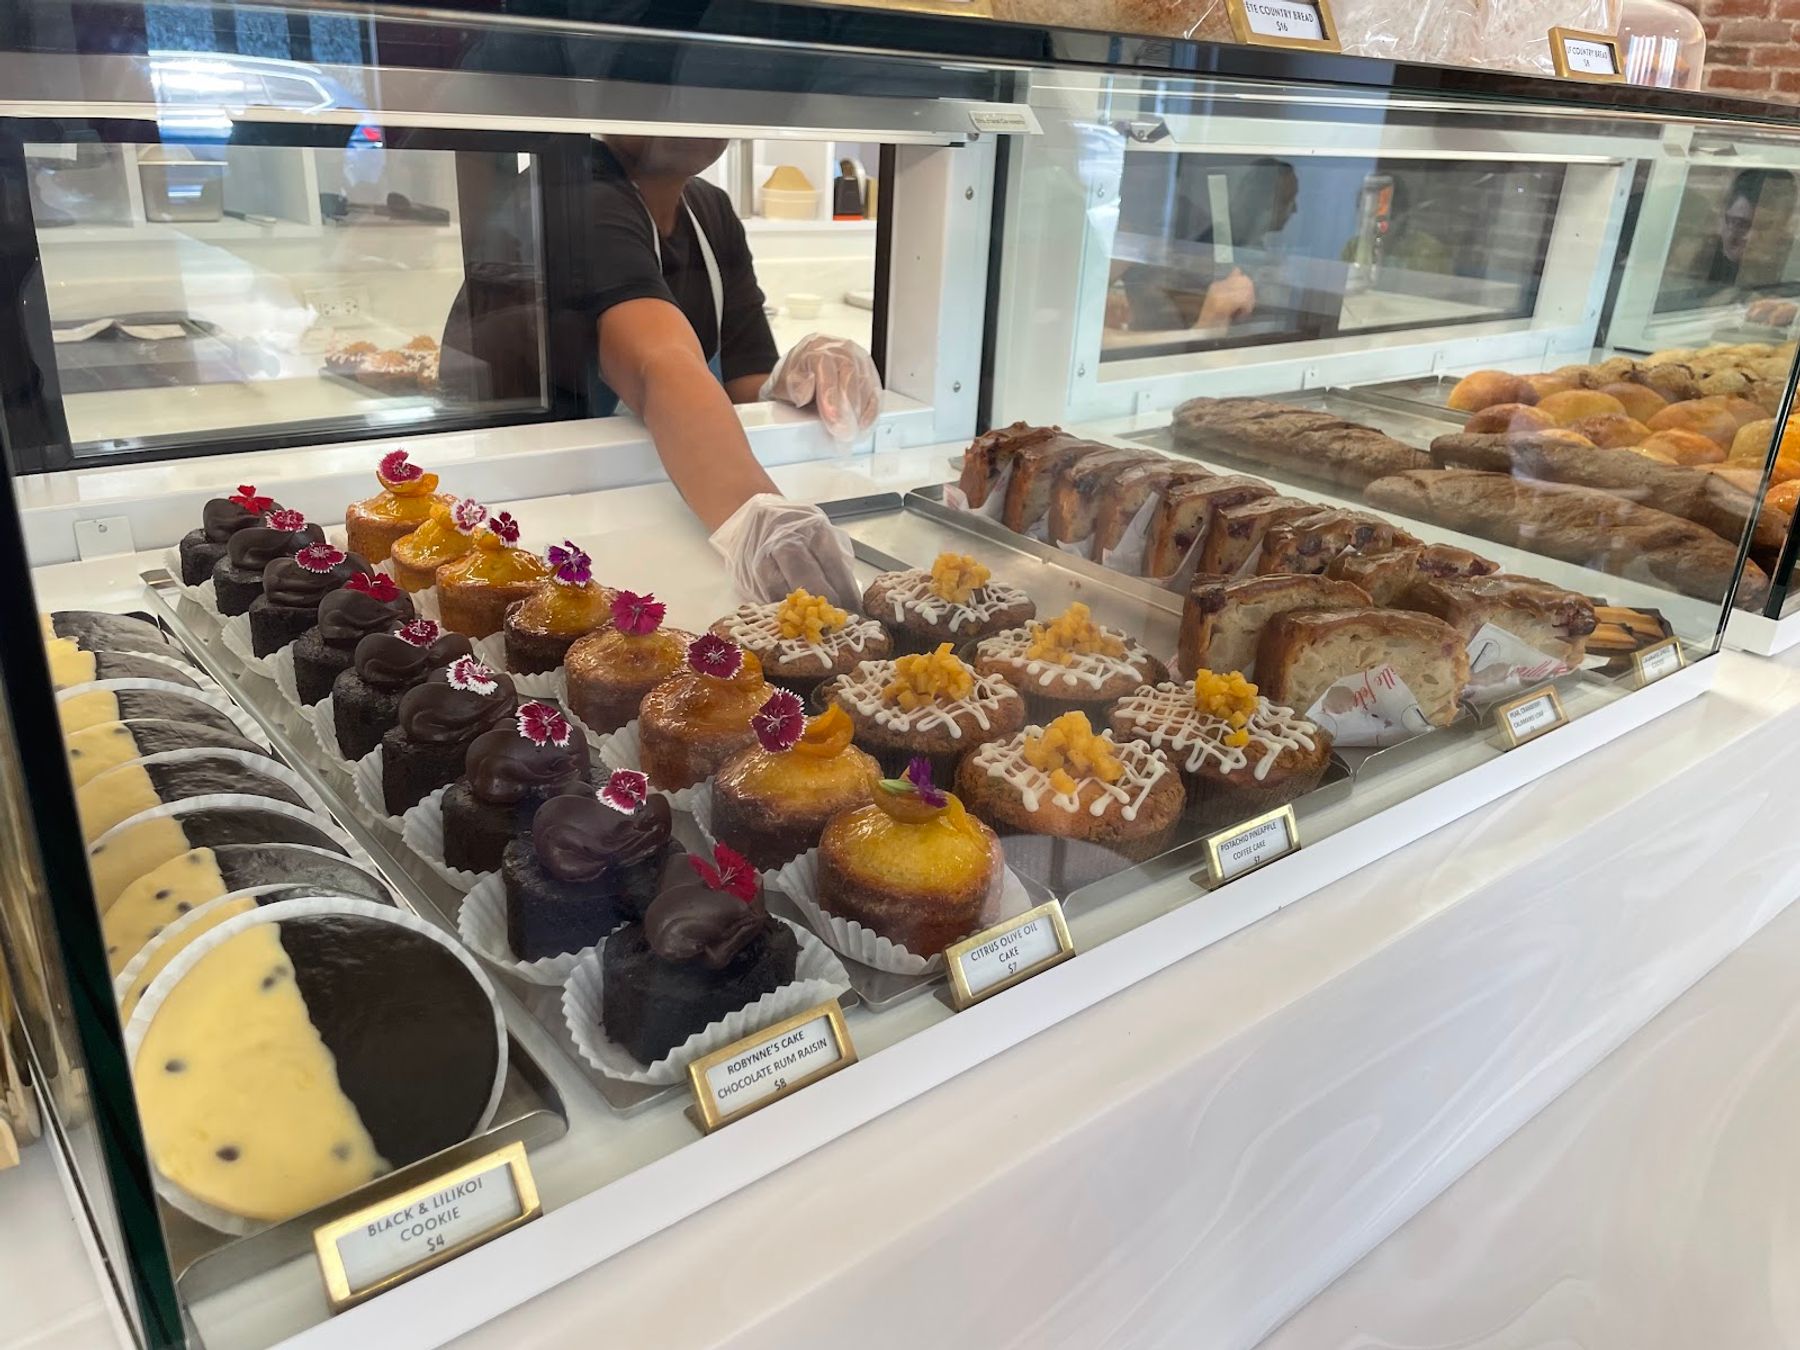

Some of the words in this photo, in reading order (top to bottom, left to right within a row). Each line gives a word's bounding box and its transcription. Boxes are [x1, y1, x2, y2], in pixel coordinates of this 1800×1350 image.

[1260, 5, 1292, 19] COUNTRY
[1293, 11, 1314, 23] BREAD
[1276, 21, 1288, 31] $16
[1572, 47, 1594, 57] COUNTRY
[1220, 834, 1249, 851] PISTACHIO
[1249, 822, 1277, 840] PINEAPPLE
[1233, 847, 1253, 860] COFFEE
[1253, 840, 1266, 851] CAKE
[970, 941, 999, 961] CITRUS
[1000, 929, 1023, 947] OLIVE
[1023, 922, 1038, 935] OIL
[998, 946, 1020, 963] CAKE
[1008, 961, 1017, 974] $7
[727, 1043, 780, 1075] ROBYNNE'S
[781, 1030, 805, 1049] CAKE
[717, 1065, 774, 1099] CHOCOLATE
[774, 1053, 797, 1071] RUM
[798, 1038, 828, 1060] RAISIN
[774, 1078, 787, 1091] $8
[367, 1207, 413, 1237] BLACK
[418, 1202, 429, 1215] &
[433, 1177, 484, 1209] LILIKOI
[400, 1206, 461, 1241] COOKIE
[426, 1233, 445, 1252] $4
